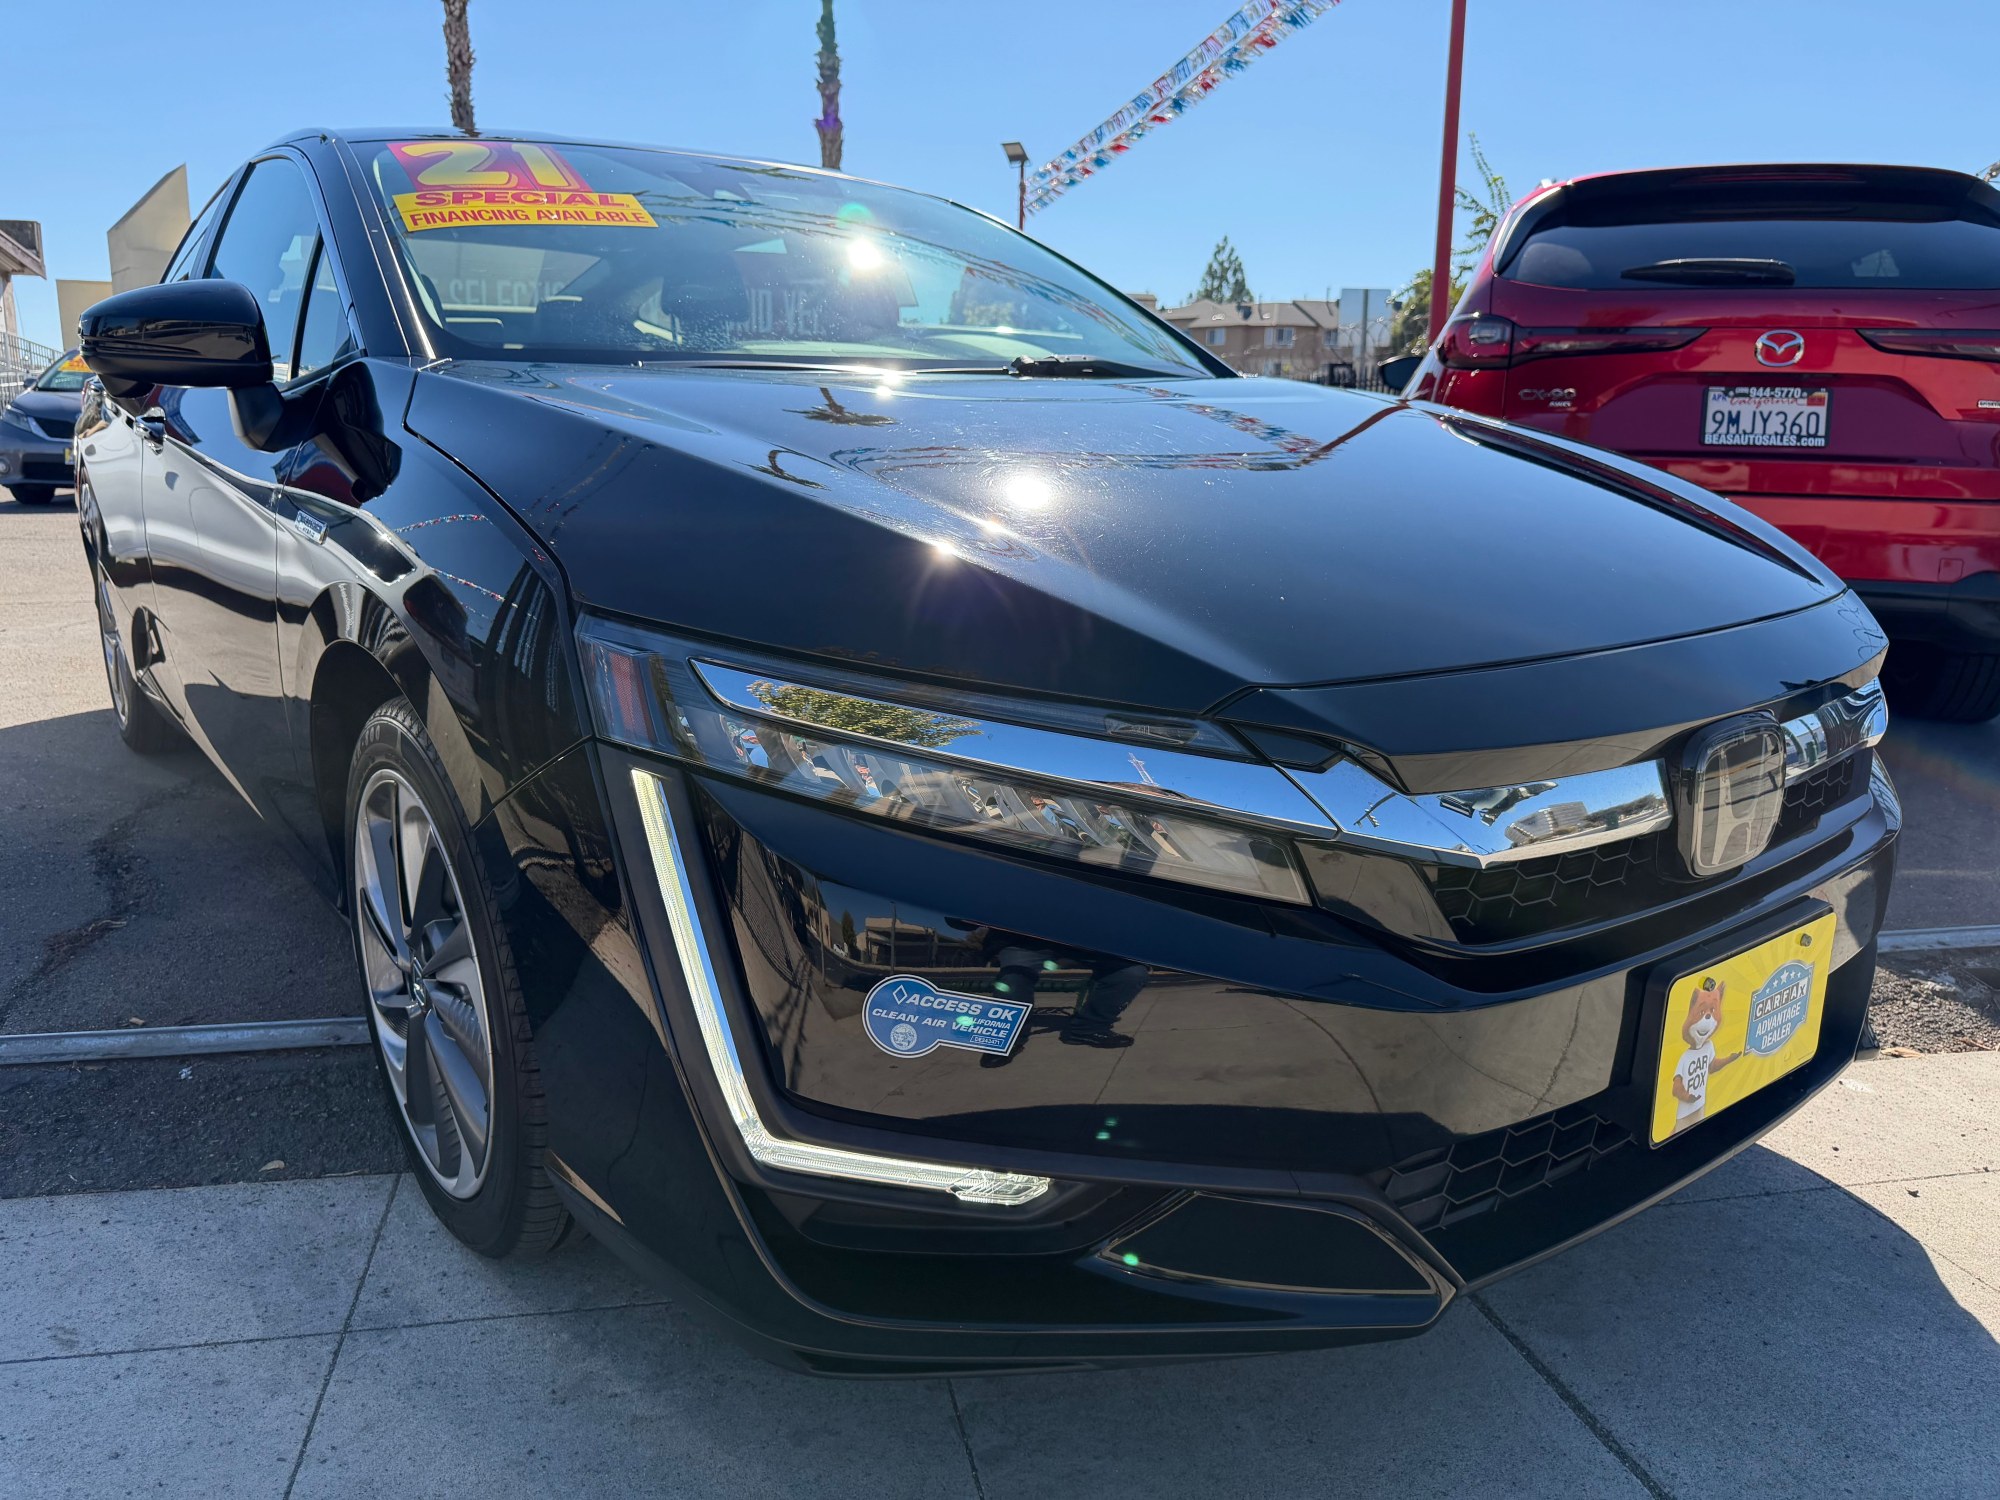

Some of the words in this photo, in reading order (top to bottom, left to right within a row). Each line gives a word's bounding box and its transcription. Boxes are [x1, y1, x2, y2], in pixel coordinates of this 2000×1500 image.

[400, 142, 581, 190] 21
[415, 191, 628, 207] SPECIAL
[409, 209, 529, 227] FINANCING
[536, 209, 649, 224] AVAILABLE
[1749, 387, 1801, 398] 944-5770
[1711, 410, 1821, 437] 9MJY360
[905, 993, 983, 1015] ACCESS
[987, 1007, 1018, 1022] OK
[1755, 982, 1808, 1018] CARFAX
[872, 1008, 919, 1024] CLEAN
[921, 1017, 947, 1028] AIR
[951, 1021, 1008, 1038] VEHICLE
[1755, 1002, 1801, 1037] ADVANTAGE
[1761, 1023, 1792, 1049] DEALER
[1687, 1054, 1708, 1077] CAR
[1687, 1072, 1706, 1092] FOX
